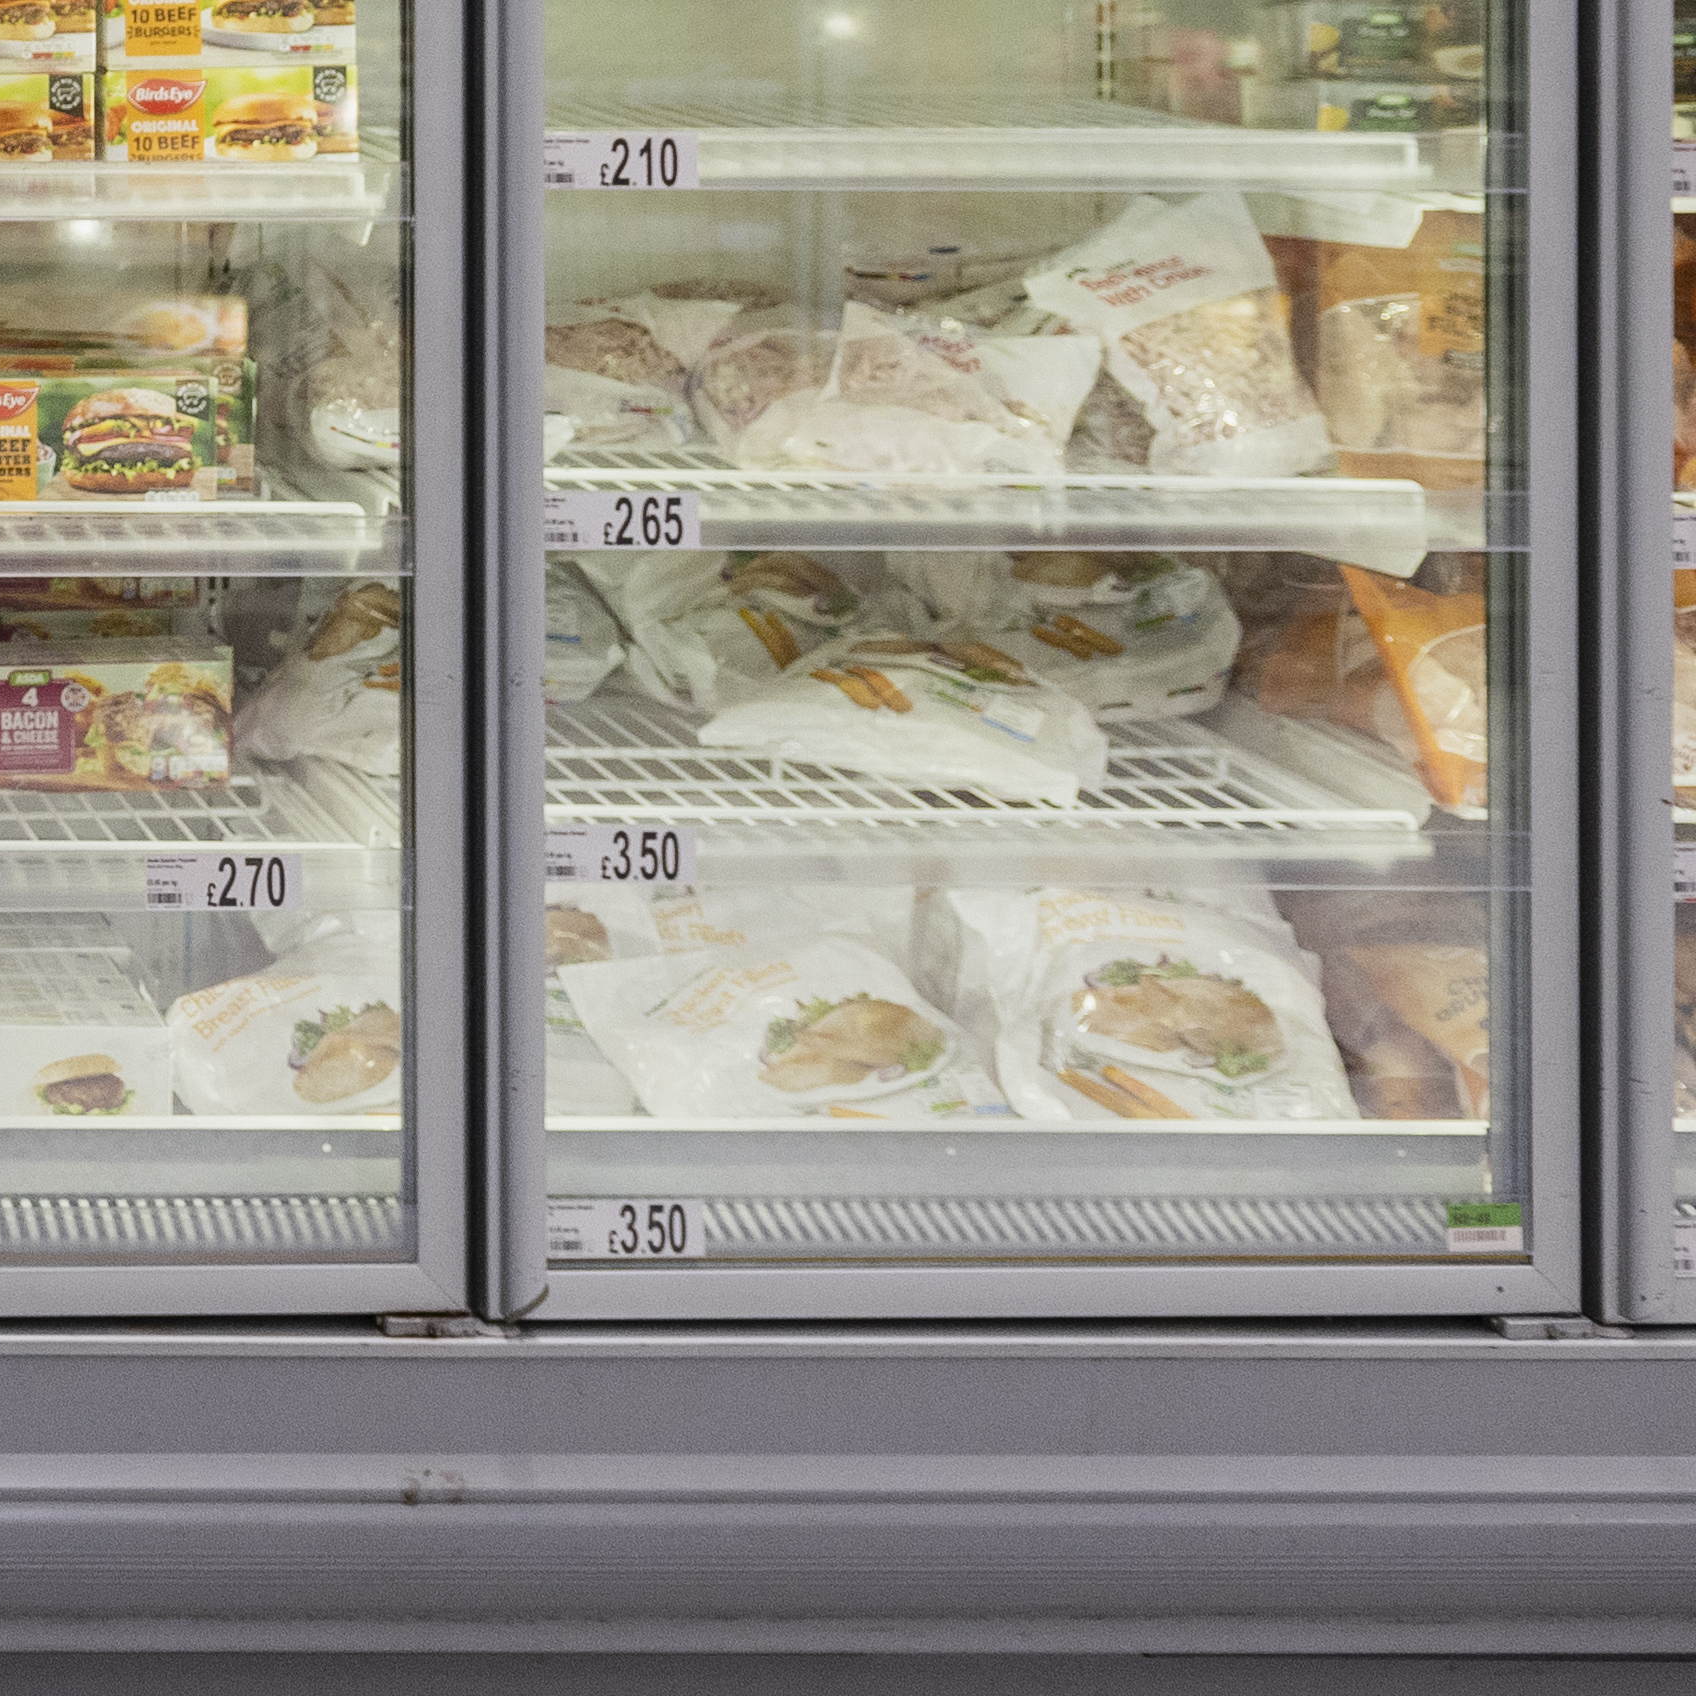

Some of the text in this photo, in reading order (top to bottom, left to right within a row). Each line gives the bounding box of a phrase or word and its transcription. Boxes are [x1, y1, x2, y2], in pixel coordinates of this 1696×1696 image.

[131, 8, 197, 24] 10 BEEF
[134, 86, 193, 103] BirdsEye
[131, 120, 198, 132] ORIGINAL
[133, 135, 200, 152] 10 BEEF
[600, 138, 678, 187] £2.10
[604, 497, 683, 546] £2.65
[21, 686, 39, 707] 4
[1, 711, 59, 730] BACON
[601, 831, 680, 881] £3.50
[206, 857, 286, 907] £2.70
[609, 1204, 687, 1255] £3.50
